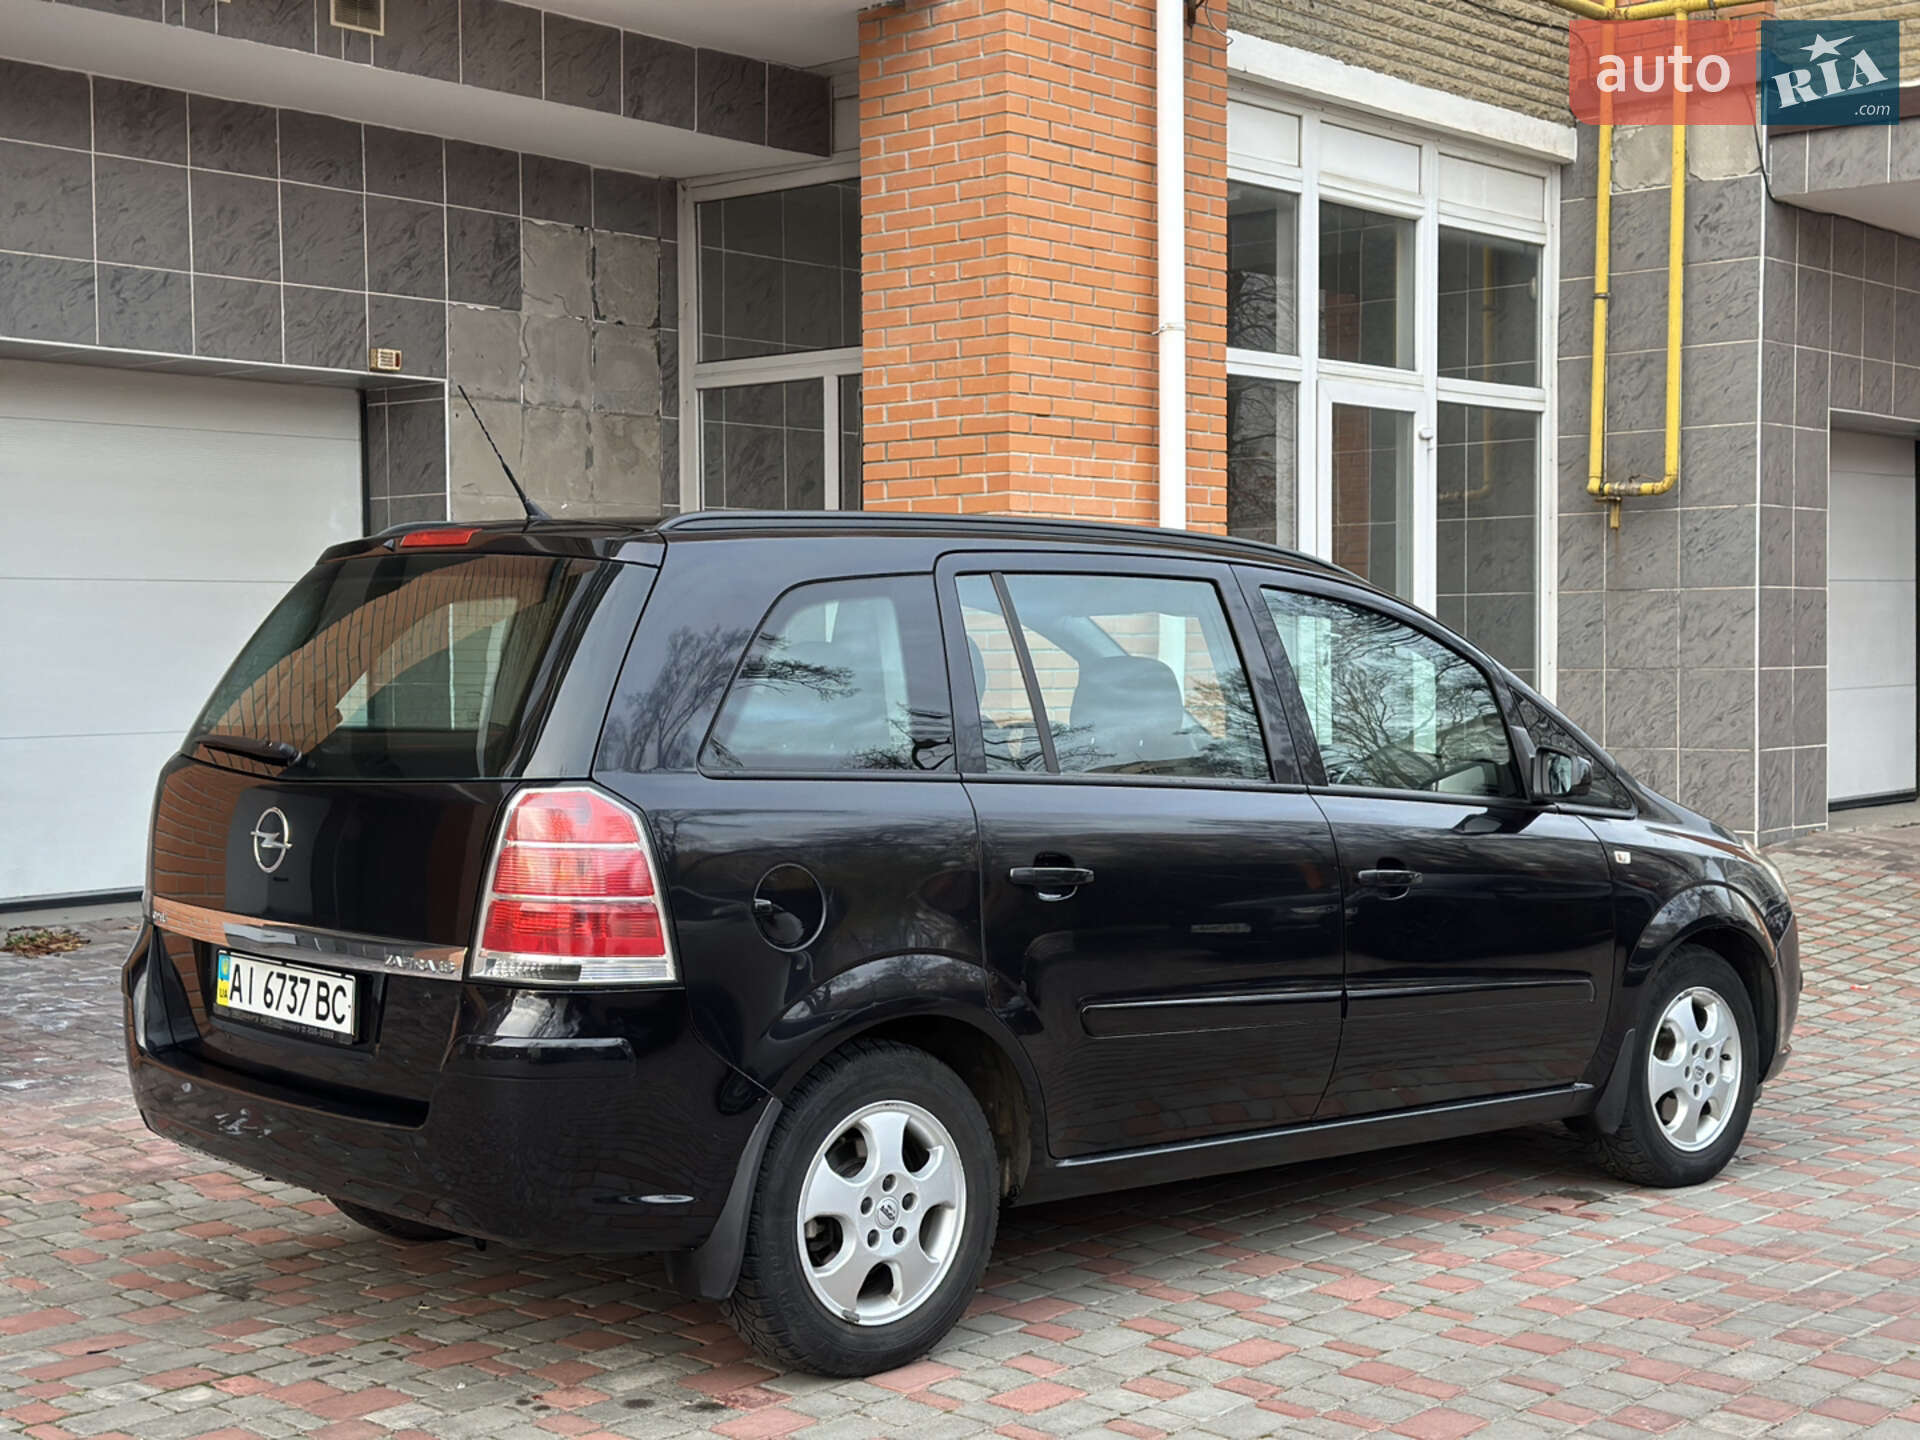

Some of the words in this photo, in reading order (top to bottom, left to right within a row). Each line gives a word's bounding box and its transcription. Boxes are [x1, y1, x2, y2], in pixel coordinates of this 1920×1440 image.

[229, 963, 254, 1005] AI
[263, 970, 311, 1017] 6737
[315, 980, 347, 1025] BC
